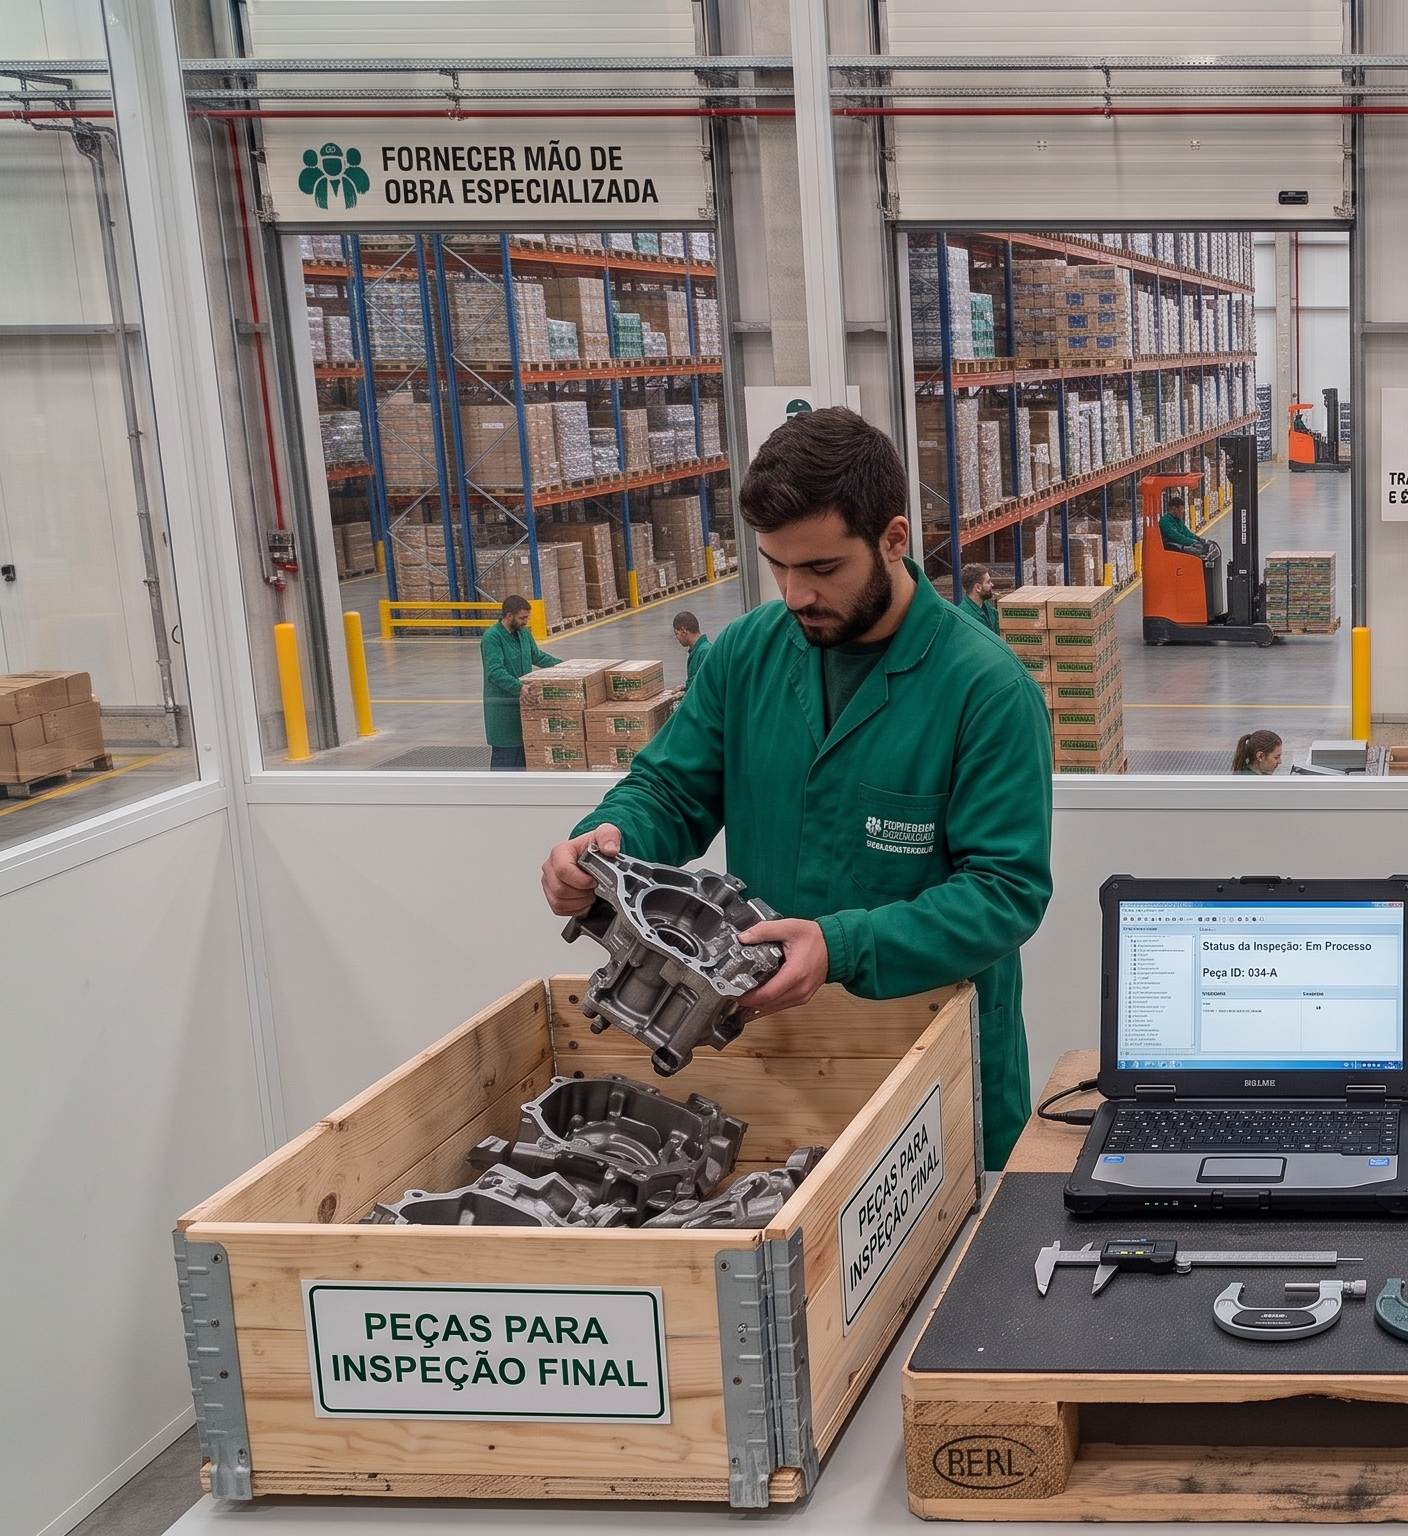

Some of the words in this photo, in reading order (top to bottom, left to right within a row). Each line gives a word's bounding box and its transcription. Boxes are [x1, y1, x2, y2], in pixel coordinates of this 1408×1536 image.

[381, 146, 516, 171] FORNECER
[525, 139, 582, 171] MÃO
[590, 146, 623, 171] DE
[384, 178, 454, 204] OBRA
[462, 178, 659, 204] ESPECIALIZADA
[1202, 941, 1235, 951] Status
[1238, 941, 1250, 951] da
[1253, 941, 1302, 953] Inspeção:
[1306, 941, 1322, 951] Em
[1325, 941, 1372, 951] Processo
[1202, 967, 1227, 979] Peça
[1231, 968, 1245, 977] ID:
[1248, 968, 1278, 977] 034-A
[858, 1164, 897, 1238] PEÇAS
[900, 1123, 929, 1179] PARA
[849, 1188, 909, 1292] INSPEÇÃO
[911, 1145, 940, 1204] FINAL
[364, 1312, 492, 1349] PEÇAS
[505, 1315, 609, 1345] PARA
[332, 1350, 526, 1391] INSPEÇÃO
[538, 1358, 648, 1387] FINAL
[947, 1449, 1024, 1476] BERL
